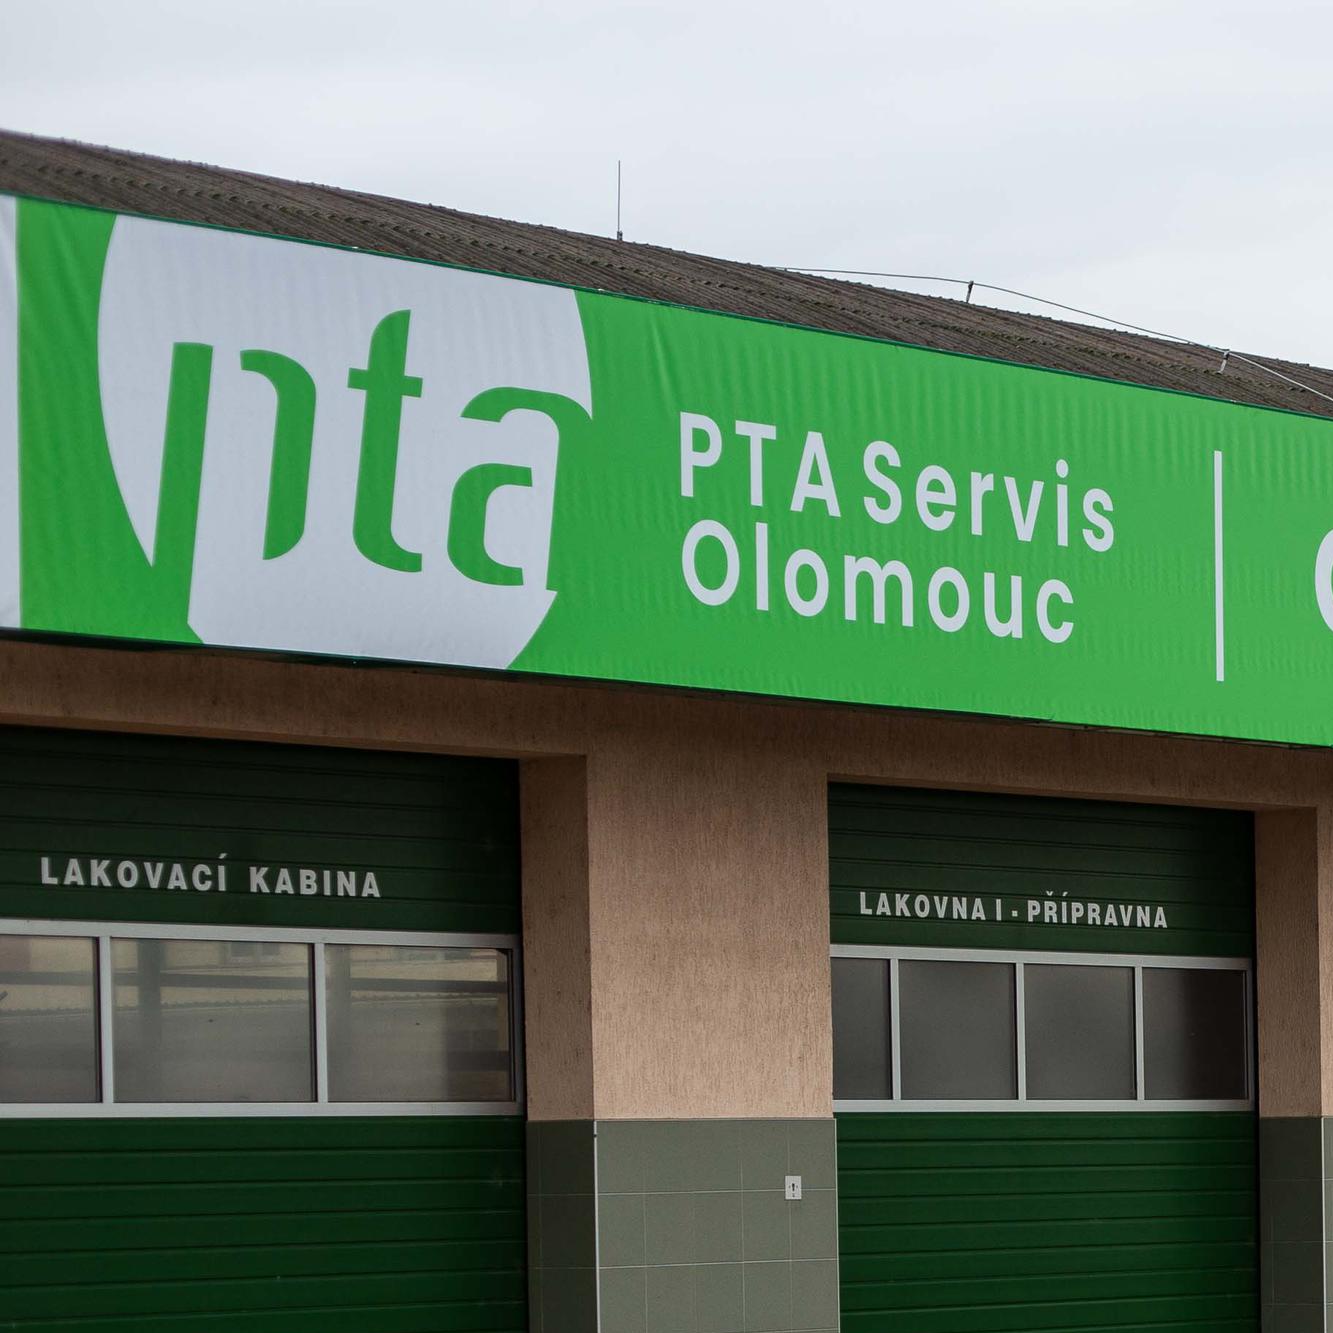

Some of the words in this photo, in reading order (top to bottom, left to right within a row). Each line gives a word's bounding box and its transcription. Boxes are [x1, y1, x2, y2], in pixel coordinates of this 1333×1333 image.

[150, 309, 592, 628] pta
[680, 411, 841, 518] PTA
[863, 440, 1115, 552] Servis
[681, 518, 1075, 643] Olomouc
[40, 852, 228, 892] LAKOVACÍ
[248, 866, 382, 898] KABINA
[859, 891, 987, 921] LAKOVNA
[995, 898, 1002, 921] I
[1027, 890, 1169, 928] PŘÍPRAVNA
